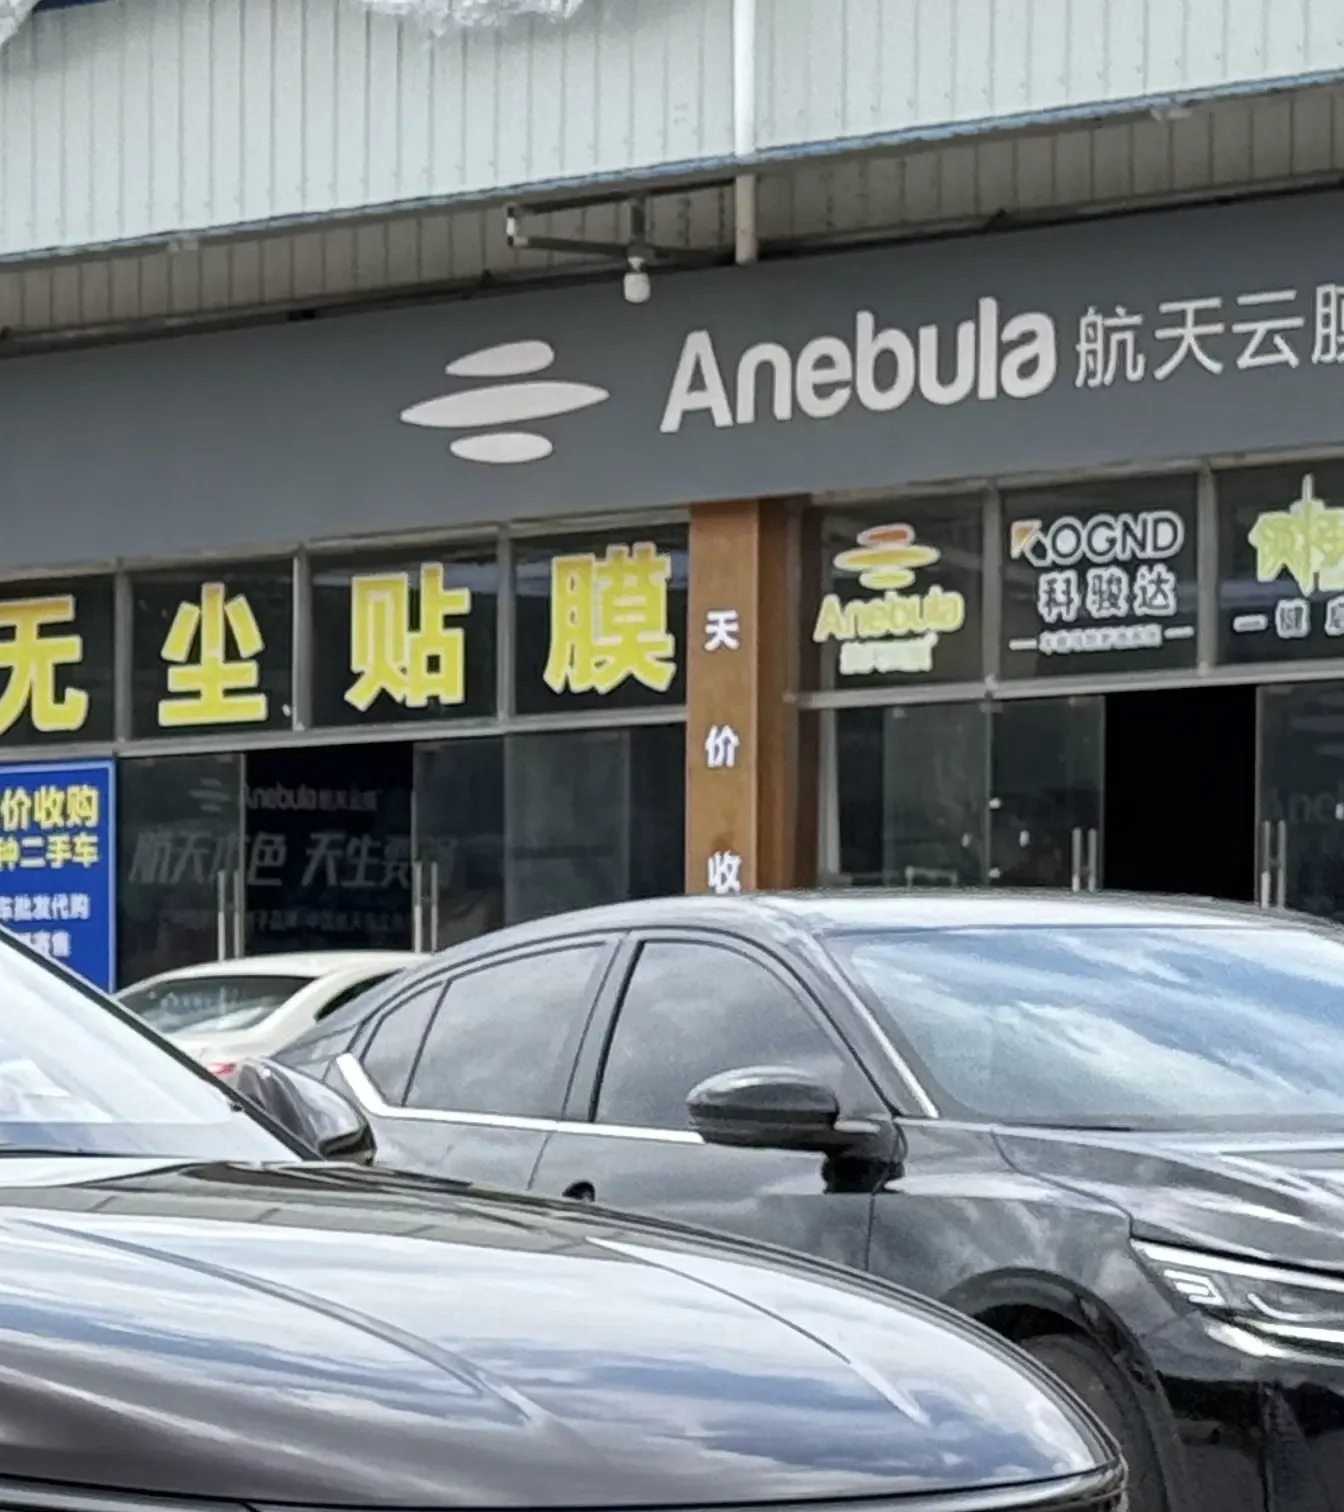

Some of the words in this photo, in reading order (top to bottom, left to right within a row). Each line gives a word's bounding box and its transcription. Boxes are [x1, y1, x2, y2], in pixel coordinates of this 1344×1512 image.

[659, 296, 1058, 433] Anebula
[814, 585, 965, 642] Anebula
[1038, 563, 1176, 622] 科骏达
